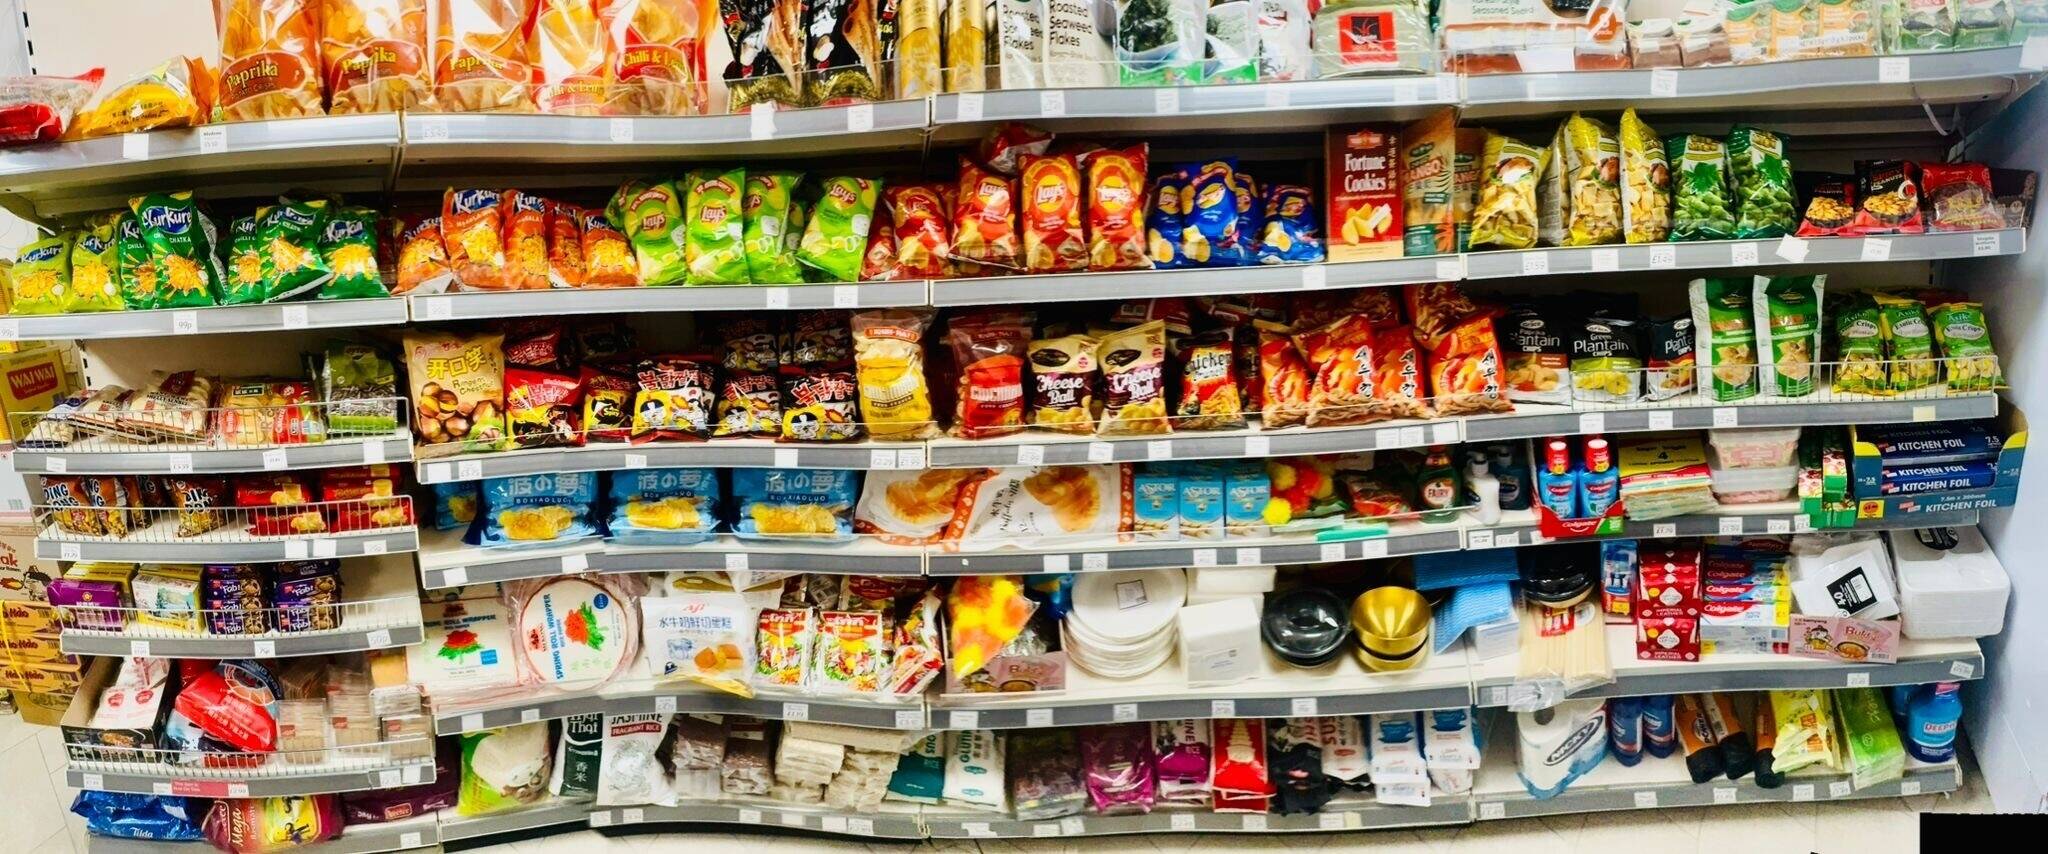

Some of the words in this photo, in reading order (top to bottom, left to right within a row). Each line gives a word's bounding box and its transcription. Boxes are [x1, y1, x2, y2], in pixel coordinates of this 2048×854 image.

[1050, 16, 1093, 35] Seaweed
[1050, 31, 1080, 47] Flakes
[226, 59, 278, 91] Paprika
[1345, 153, 1386, 173] Fortune
[1345, 175, 1387, 194] Cookies
[830, 184, 858, 205] Lay's
[1035, 183, 1067, 205] Lay's
[143, 205, 192, 230] Kurkure
[701, 205, 728, 223] Lay's
[178, 320, 192, 330] 99p
[1590, 333, 1612, 341] Green
[1573, 340, 1630, 353] Plantain
[427, 345, 487, 380] 开口笑
[9, 371, 36, 389] WAI
[1036, 374, 1083, 390] Cheese
[1047, 388, 1075, 405] Ball
[1127, 380, 1155, 401] Ball
[1897, 440, 1943, 451] KITCHEN
[1943, 438, 1966, 448] FOIL
[1985, 436, 2000, 444] 7.5
[1659, 451, 1669, 460] 4
[1898, 467, 1944, 477] KITCHEN
[1945, 465, 1968, 473] FOIL
[1139, 483, 1176, 495] ASTOR
[1229, 486, 1269, 498] ASTOR
[1902, 480, 1948, 492] KITCHEN
[1949, 478, 1972, 488] FOIL
[1182, 487, 1221, 498] ASTOR
[1428, 488, 1449, 498] FAIRY
[1925, 501, 1973, 513] KITCHEN
[1974, 499, 1998, 509] FOIL
[1561, 520, 1598, 529] Colgate
[1707, 570, 1746, 579] Colgate
[222, 581, 241, 595] Fab!
[295, 584, 314, 597] Fab!
[1705, 585, 1747, 595] Colgate
[543, 593, 555, 629] WRAPPER
[1703, 604, 1745, 614] Colgate
[549, 630, 559, 650] ROLL
[552, 651, 565, 681] SPRING
[646, 723, 661, 733] RICE
[1698, 714, 1712, 745] POWER
[576, 761, 588, 783] 香米
[130, 826, 154, 838] Tilda
[231, 807, 249, 848] Mega
